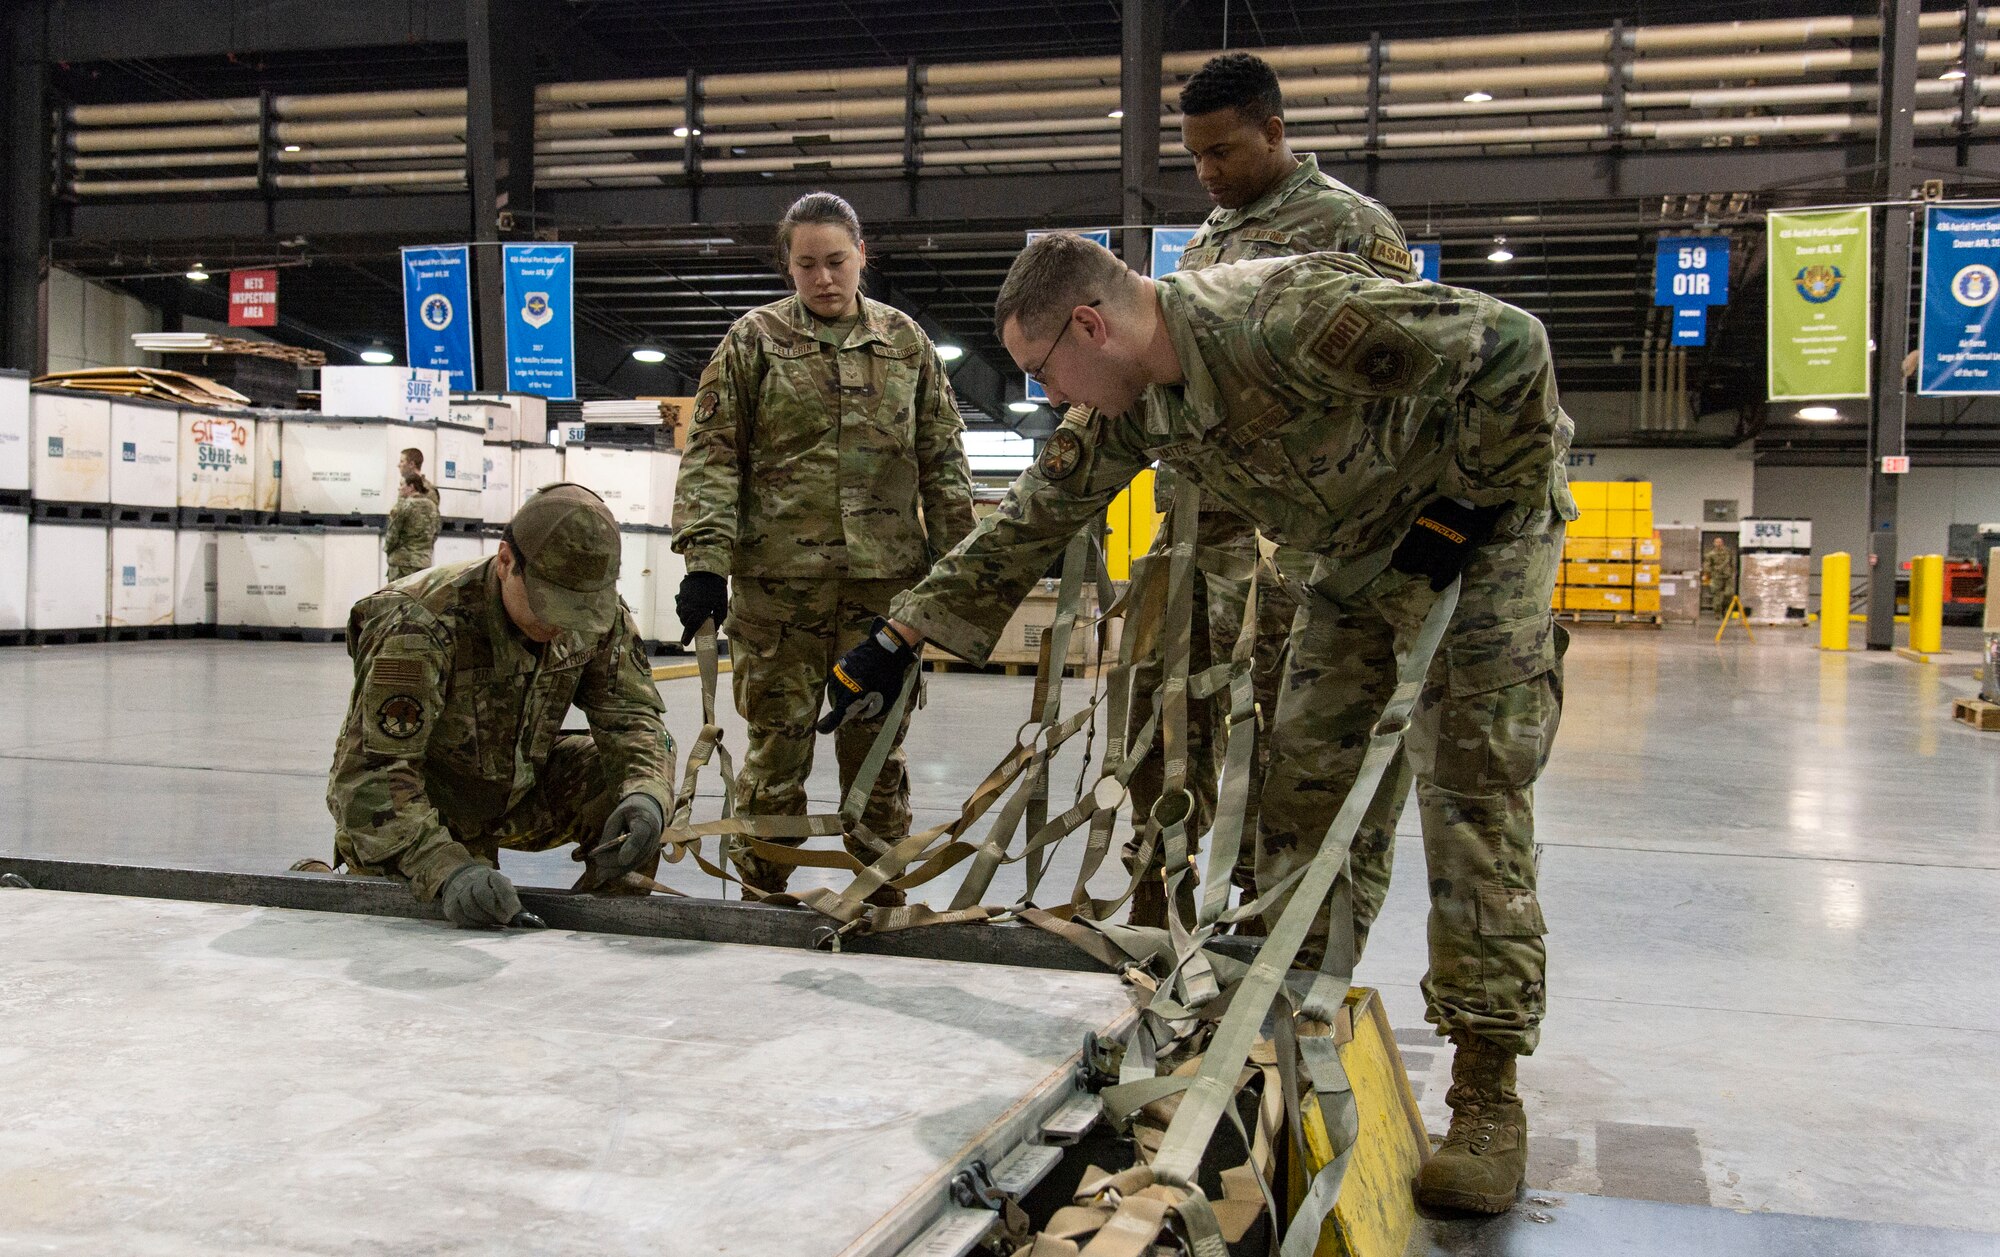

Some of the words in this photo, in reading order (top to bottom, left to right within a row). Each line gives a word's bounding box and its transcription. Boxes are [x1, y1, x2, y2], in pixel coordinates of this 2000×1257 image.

[1951, 222, 1971, 231] Aerial
[1971, 222, 1986, 231] Port
[1795, 246, 1816, 255] Dover
[1833, 244, 1842, 253] DE
[1953, 239, 1975, 248] Dover
[1377, 243, 1408, 265] ASM
[1678, 247, 1707, 269] 59
[1672, 273, 1710, 296] 01R
[232, 292, 276, 304] INSPECTION
[243, 306, 263, 318] AREA
[1318, 308, 1363, 362] PORT
[772, 344, 813, 357] PELLERIN
[49, 445, 63, 457] GSA
[122, 451, 136, 460] GSA
[1565, 452, 1597, 466] IFT
[1887, 458, 1905, 472] EXIT
